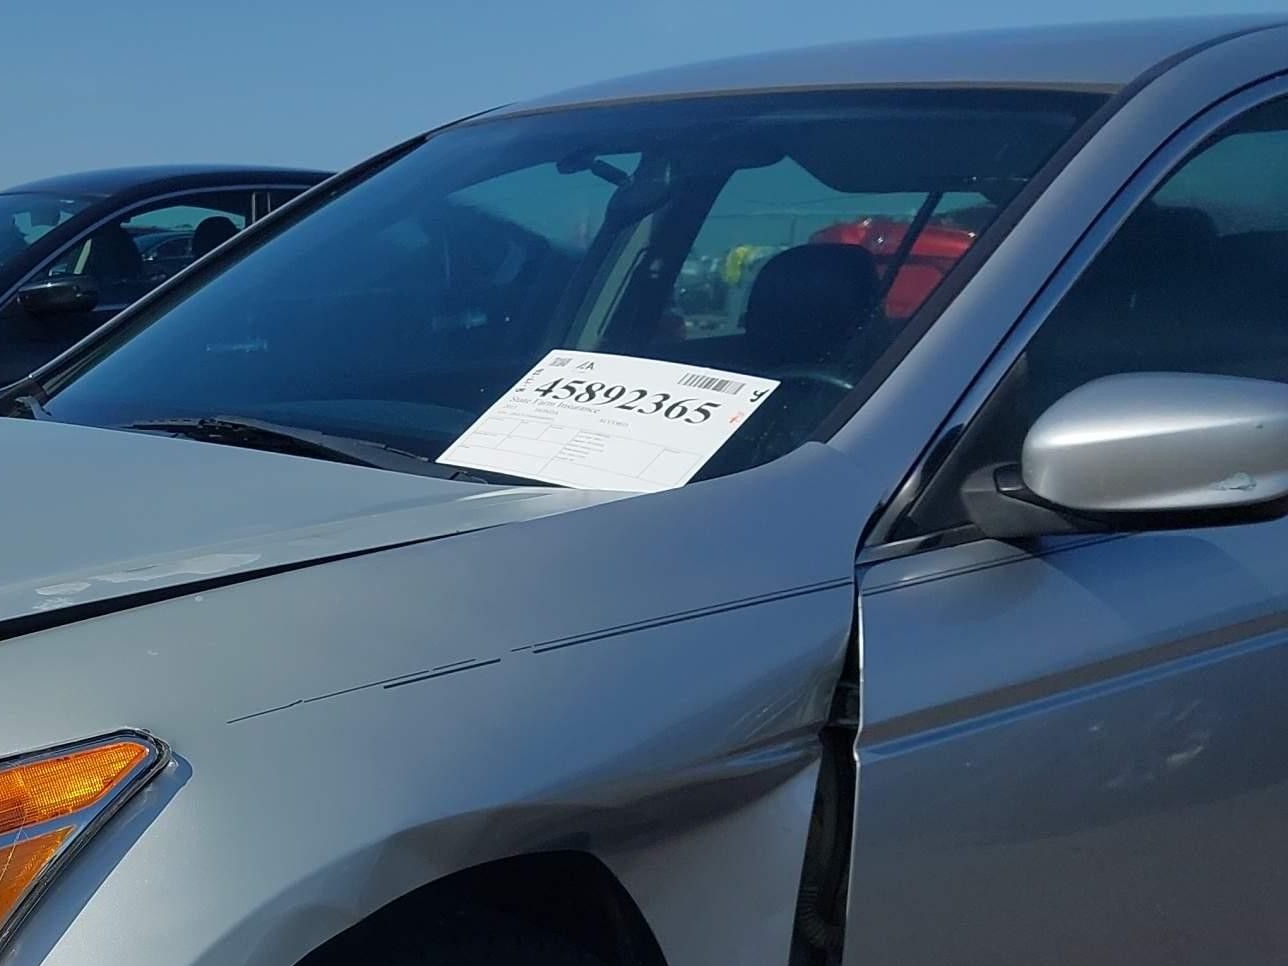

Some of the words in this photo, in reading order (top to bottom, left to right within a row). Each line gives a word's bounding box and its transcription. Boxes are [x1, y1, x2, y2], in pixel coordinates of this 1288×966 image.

[509, 396, 532, 405] State
[532, 398, 557, 407] Farm
[558, 402, 601, 414] Insurance
[534, 377, 722, 424] 45892365
